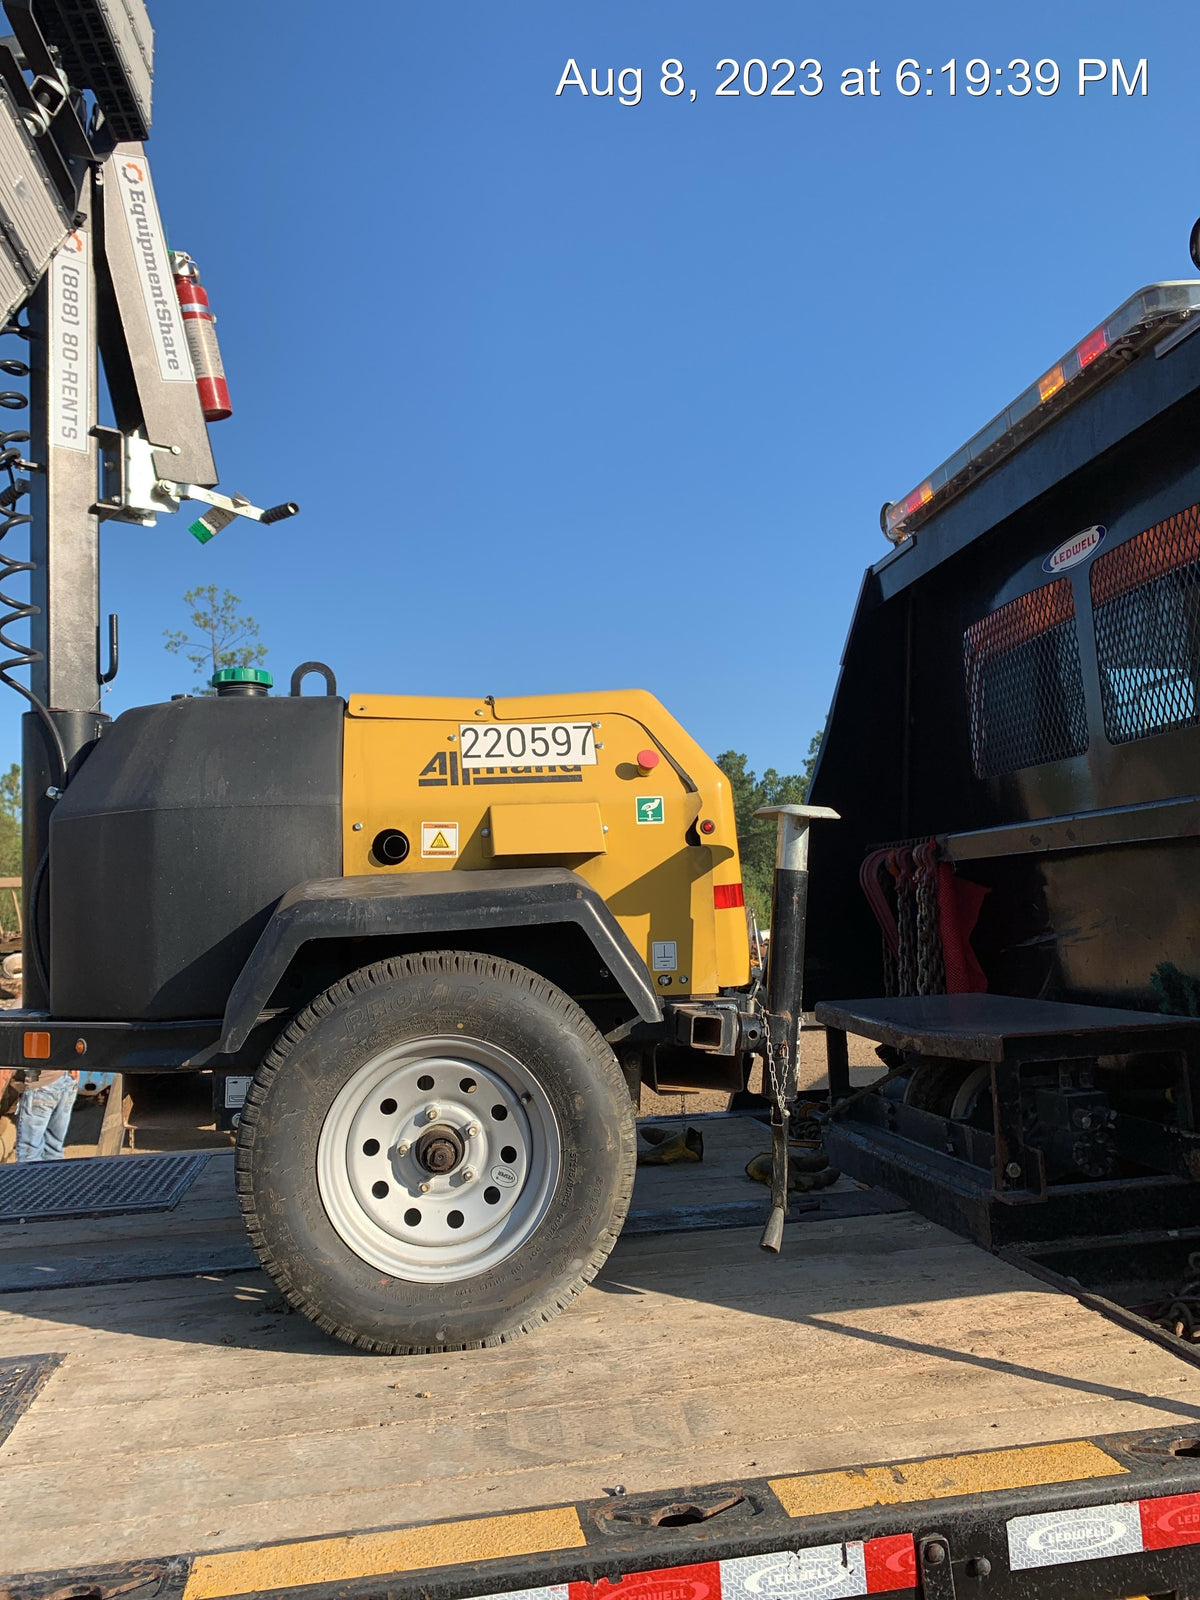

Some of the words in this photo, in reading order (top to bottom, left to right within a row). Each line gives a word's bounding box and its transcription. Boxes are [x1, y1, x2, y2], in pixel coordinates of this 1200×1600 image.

[129, 188, 180, 370] EquipmentShare
[61, 264, 80, 326] (888)
[61, 332, 79, 440] 80-RENTS
[1053, 534, 1097, 565] LEDWELL
[461, 725, 592, 759] 220597
[1049, 1526, 1109, 1543] LEDWELL
[1177, 1513, 1200, 1525] LED
[767, 1568, 832, 1585] LEDWELL
[621, 1589, 687, 1600] EDWELL
